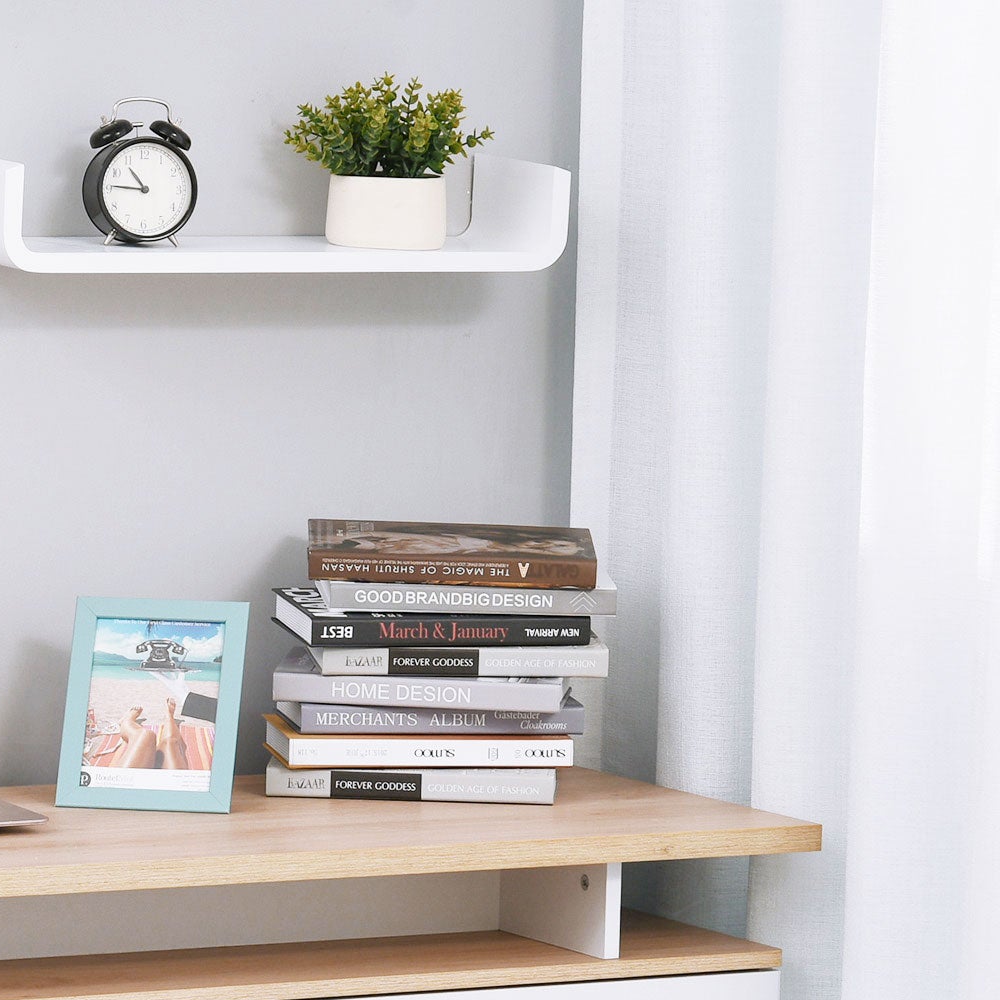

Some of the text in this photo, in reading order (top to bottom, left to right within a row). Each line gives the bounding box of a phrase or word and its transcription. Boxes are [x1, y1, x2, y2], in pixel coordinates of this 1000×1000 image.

[321, 563, 510, 577] THE MAGIC OF SHRUTI HAASAN
[320, 625, 354, 639] BEST
[379, 621, 509, 642] March & January
[524, 628, 580, 637] NEW ARRIVAL
[392, 657, 474, 667] FOREVER GODDESS
[485, 657, 597, 669] GOLDEN AGE OF FASHION
[331, 681, 390, 700] HOME
[315, 712, 486, 727] MERCHANTS ALBUM
[520, 719, 568, 730] Cloakrooms
[335, 779, 417, 792] FOREVER GODDESS
[427, 784, 541, 796] GOLDEN AGE OF FASHION
